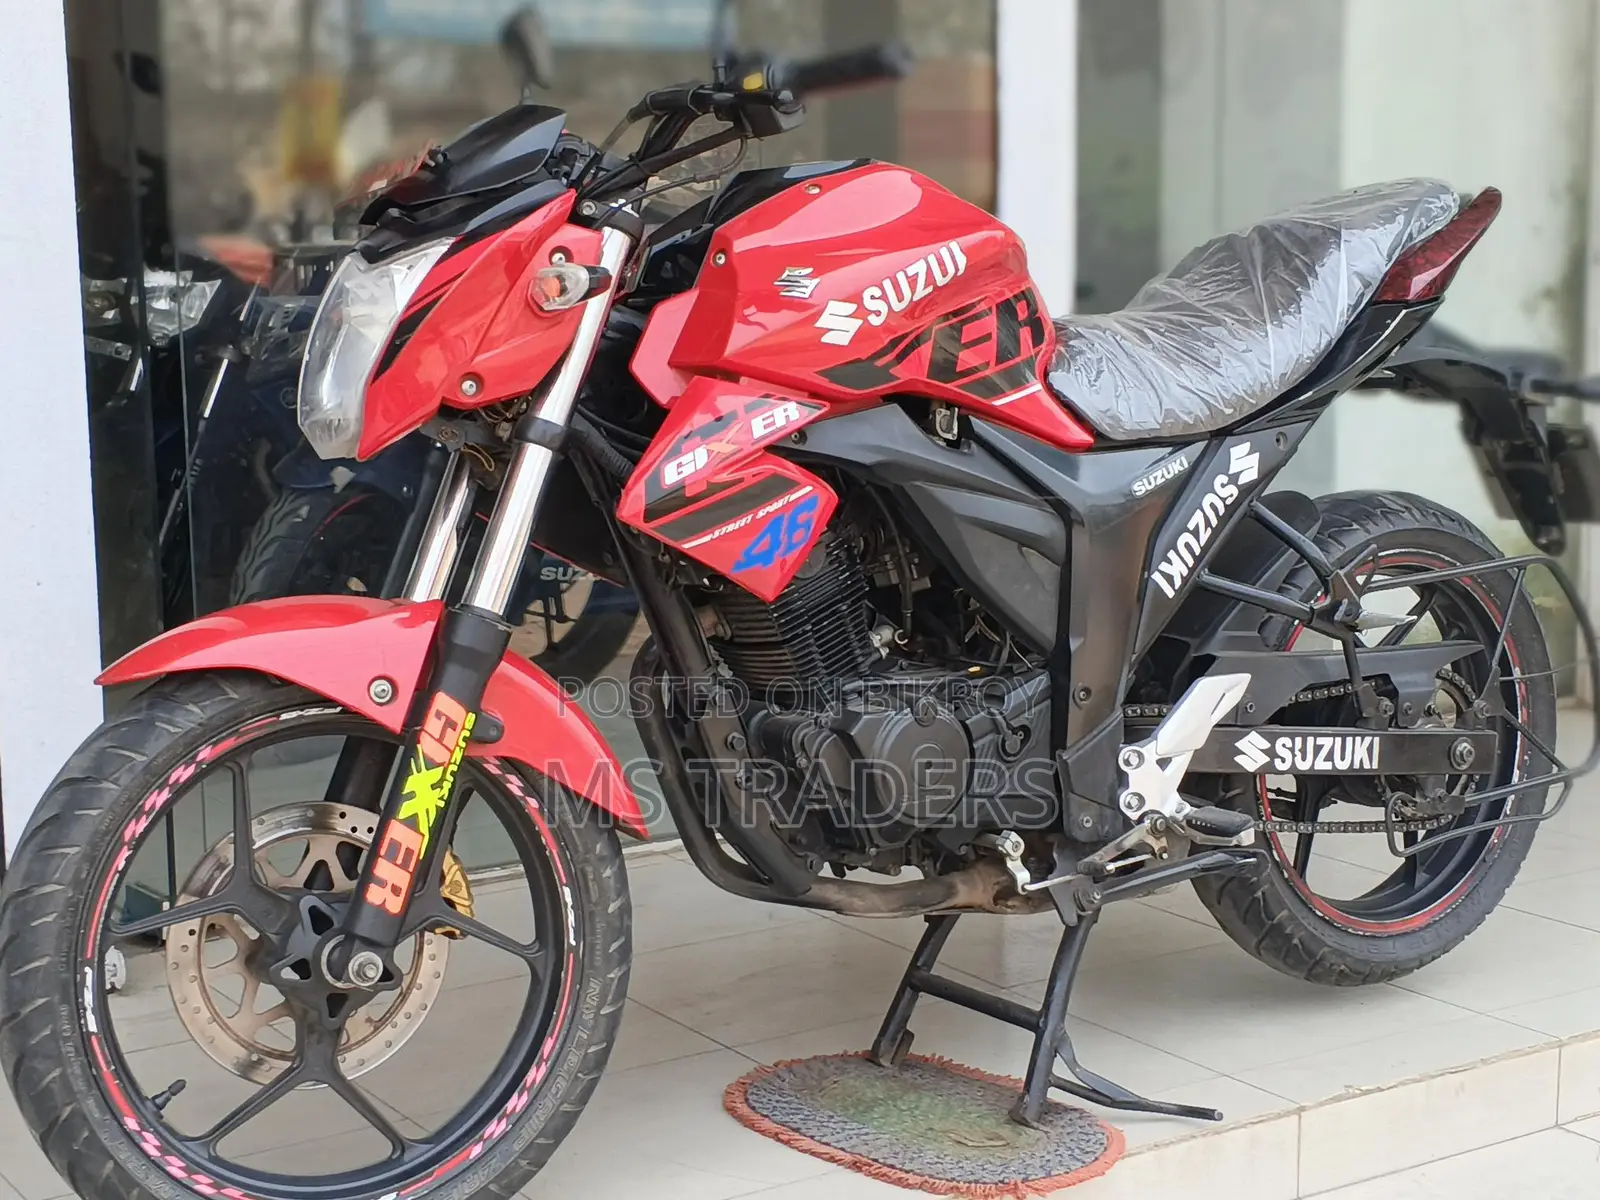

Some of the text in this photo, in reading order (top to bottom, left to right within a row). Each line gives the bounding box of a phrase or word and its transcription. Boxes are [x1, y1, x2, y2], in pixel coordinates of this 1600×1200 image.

[1132, 455, 1189, 496] SUZUKI
[730, 494, 819, 574] 46
[1150, 474, 1240, 599] SUZUKI
[1273, 735, 1381, 771] SUZUKI
